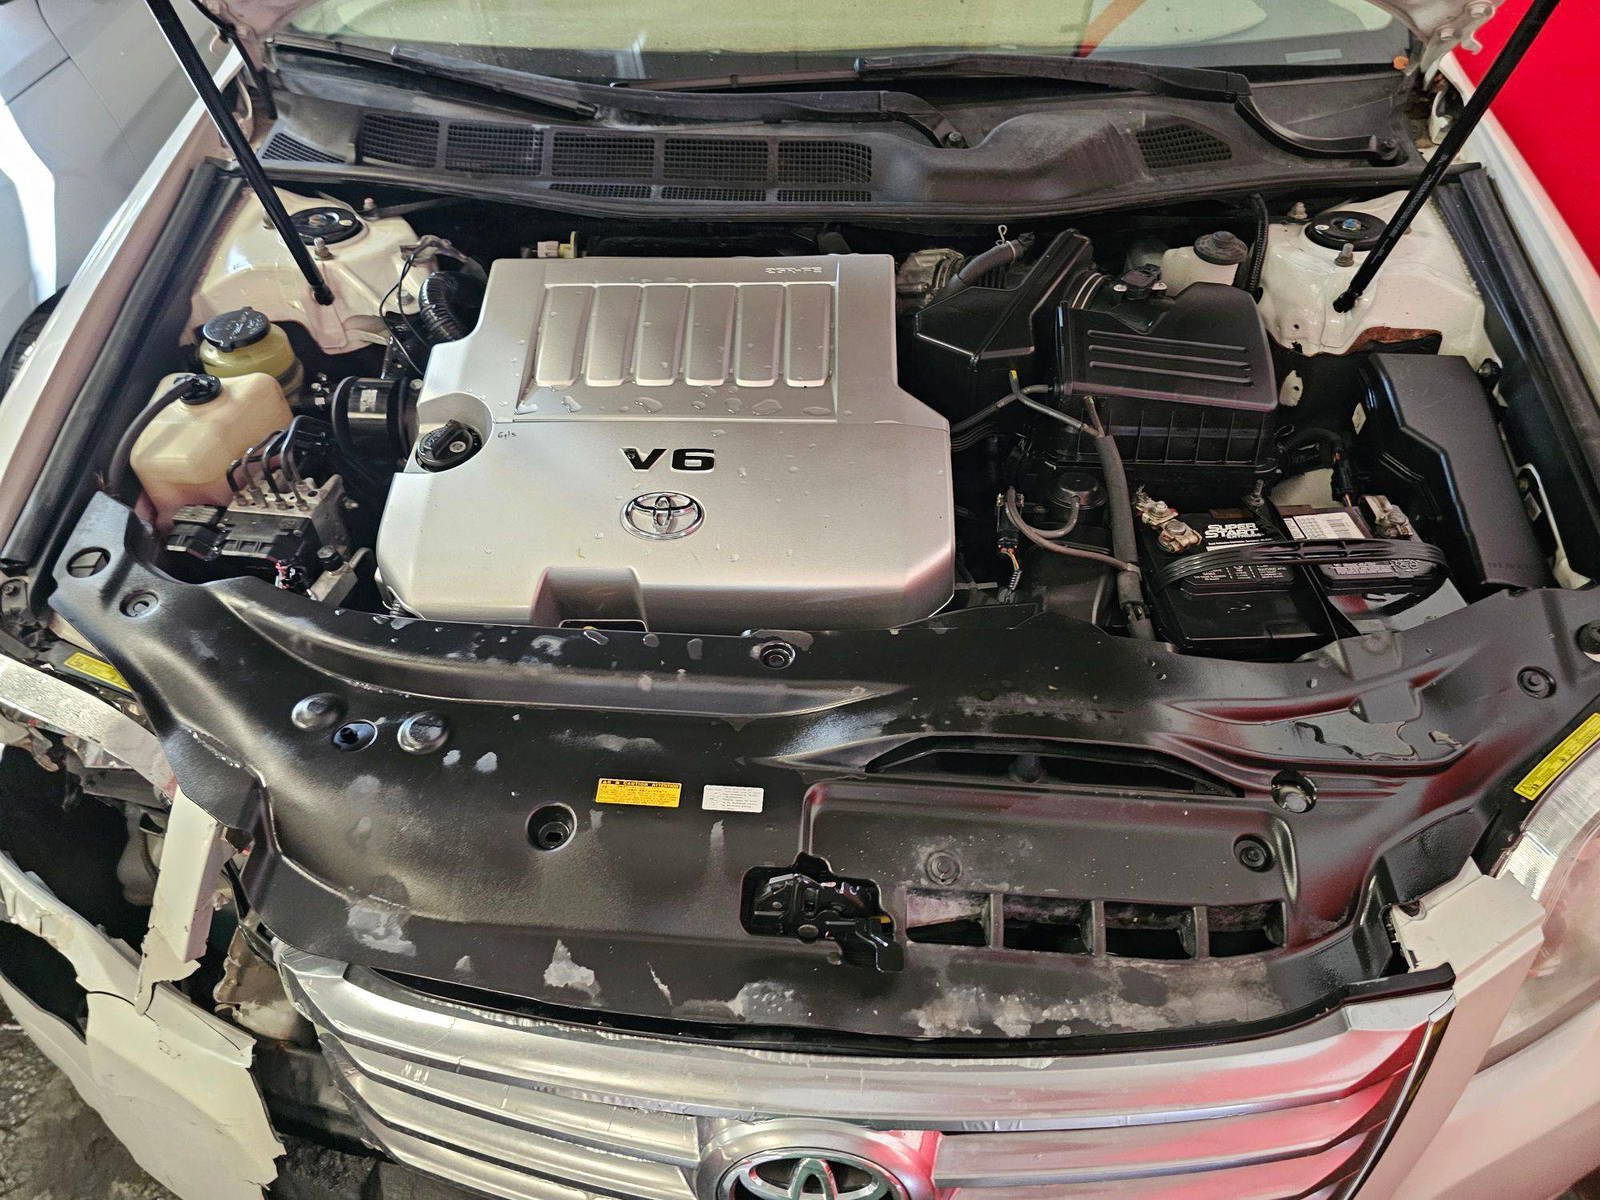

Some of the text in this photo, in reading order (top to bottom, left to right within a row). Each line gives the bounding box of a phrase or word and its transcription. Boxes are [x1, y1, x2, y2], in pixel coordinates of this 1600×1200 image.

[620, 447, 716, 472] V6
[1207, 522, 1257, 532] SUPER
[1204, 528, 1259, 539] START
